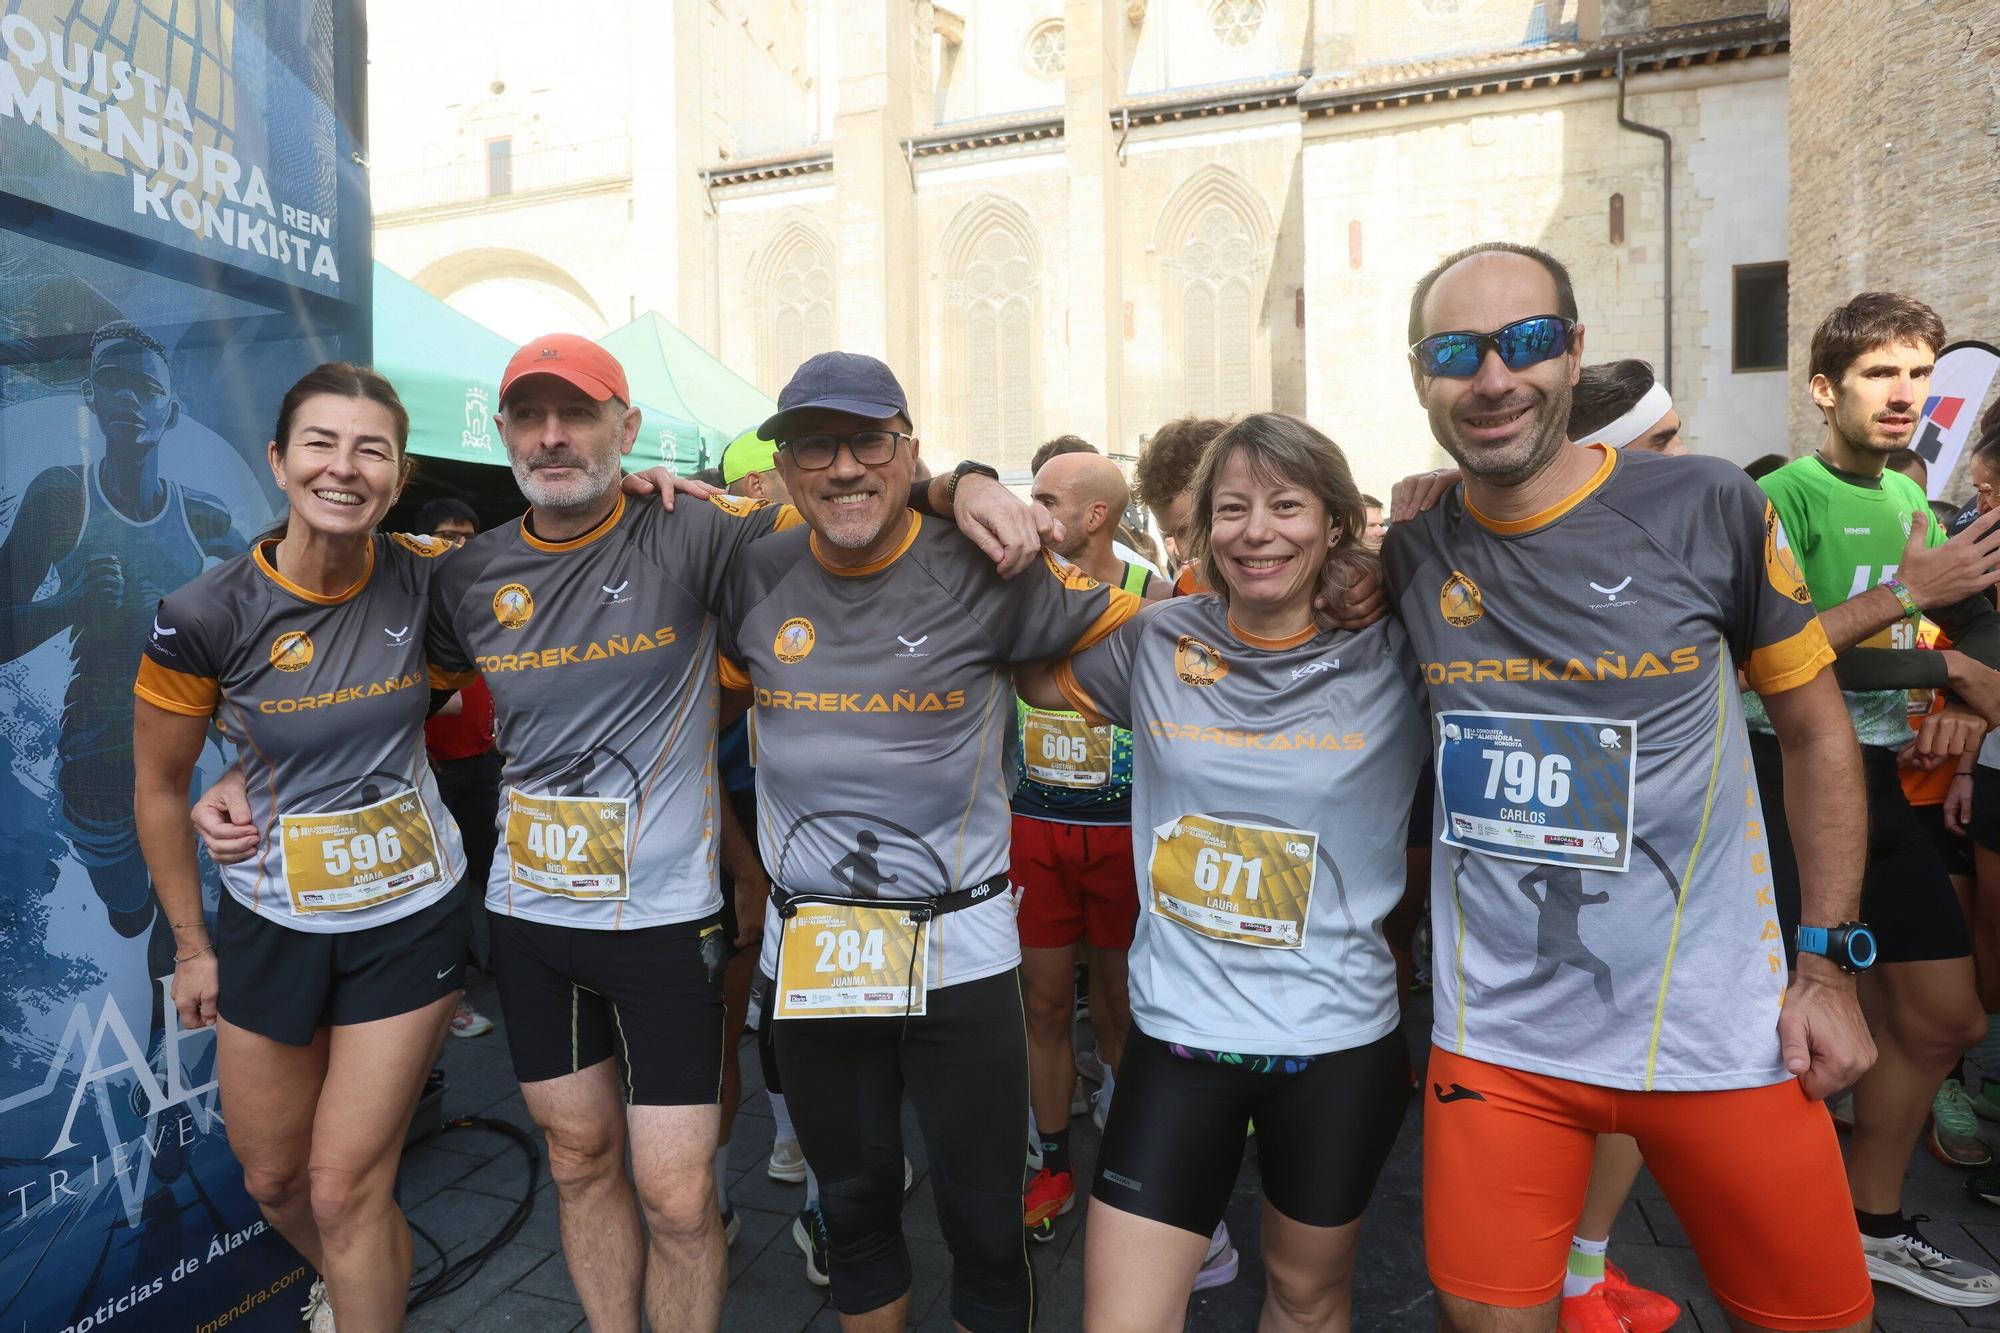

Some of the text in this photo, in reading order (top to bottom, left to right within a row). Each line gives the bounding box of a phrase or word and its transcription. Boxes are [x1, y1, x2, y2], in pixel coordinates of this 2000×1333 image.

[1, 13, 193, 133] QUISTA
[0, 59, 330, 239] MENDRA REN
[133, 172, 339, 282] KONKISTA
[259, 671, 422, 715] CORREKAÑAS
[753, 689, 965, 712] ORREKAÑAS
[1042, 733, 1087, 763] 605
[1482, 749, 1572, 807] 796
[400, 798, 415, 814] 10K
[600, 809, 618, 820] 10K
[1500, 808, 1546, 824] CARLOS
[322, 826, 402, 876] 596
[527, 822, 588, 862] 402
[353, 871, 385, 886] AMAIA
[1194, 848, 1262, 900] 671
[971, 883, 990, 898] edp
[1206, 897, 1240, 912] LAURA
[815, 929, 886, 973] 284
[831, 976, 866, 987] JUANMA
[171, 1259, 199, 1283] de
